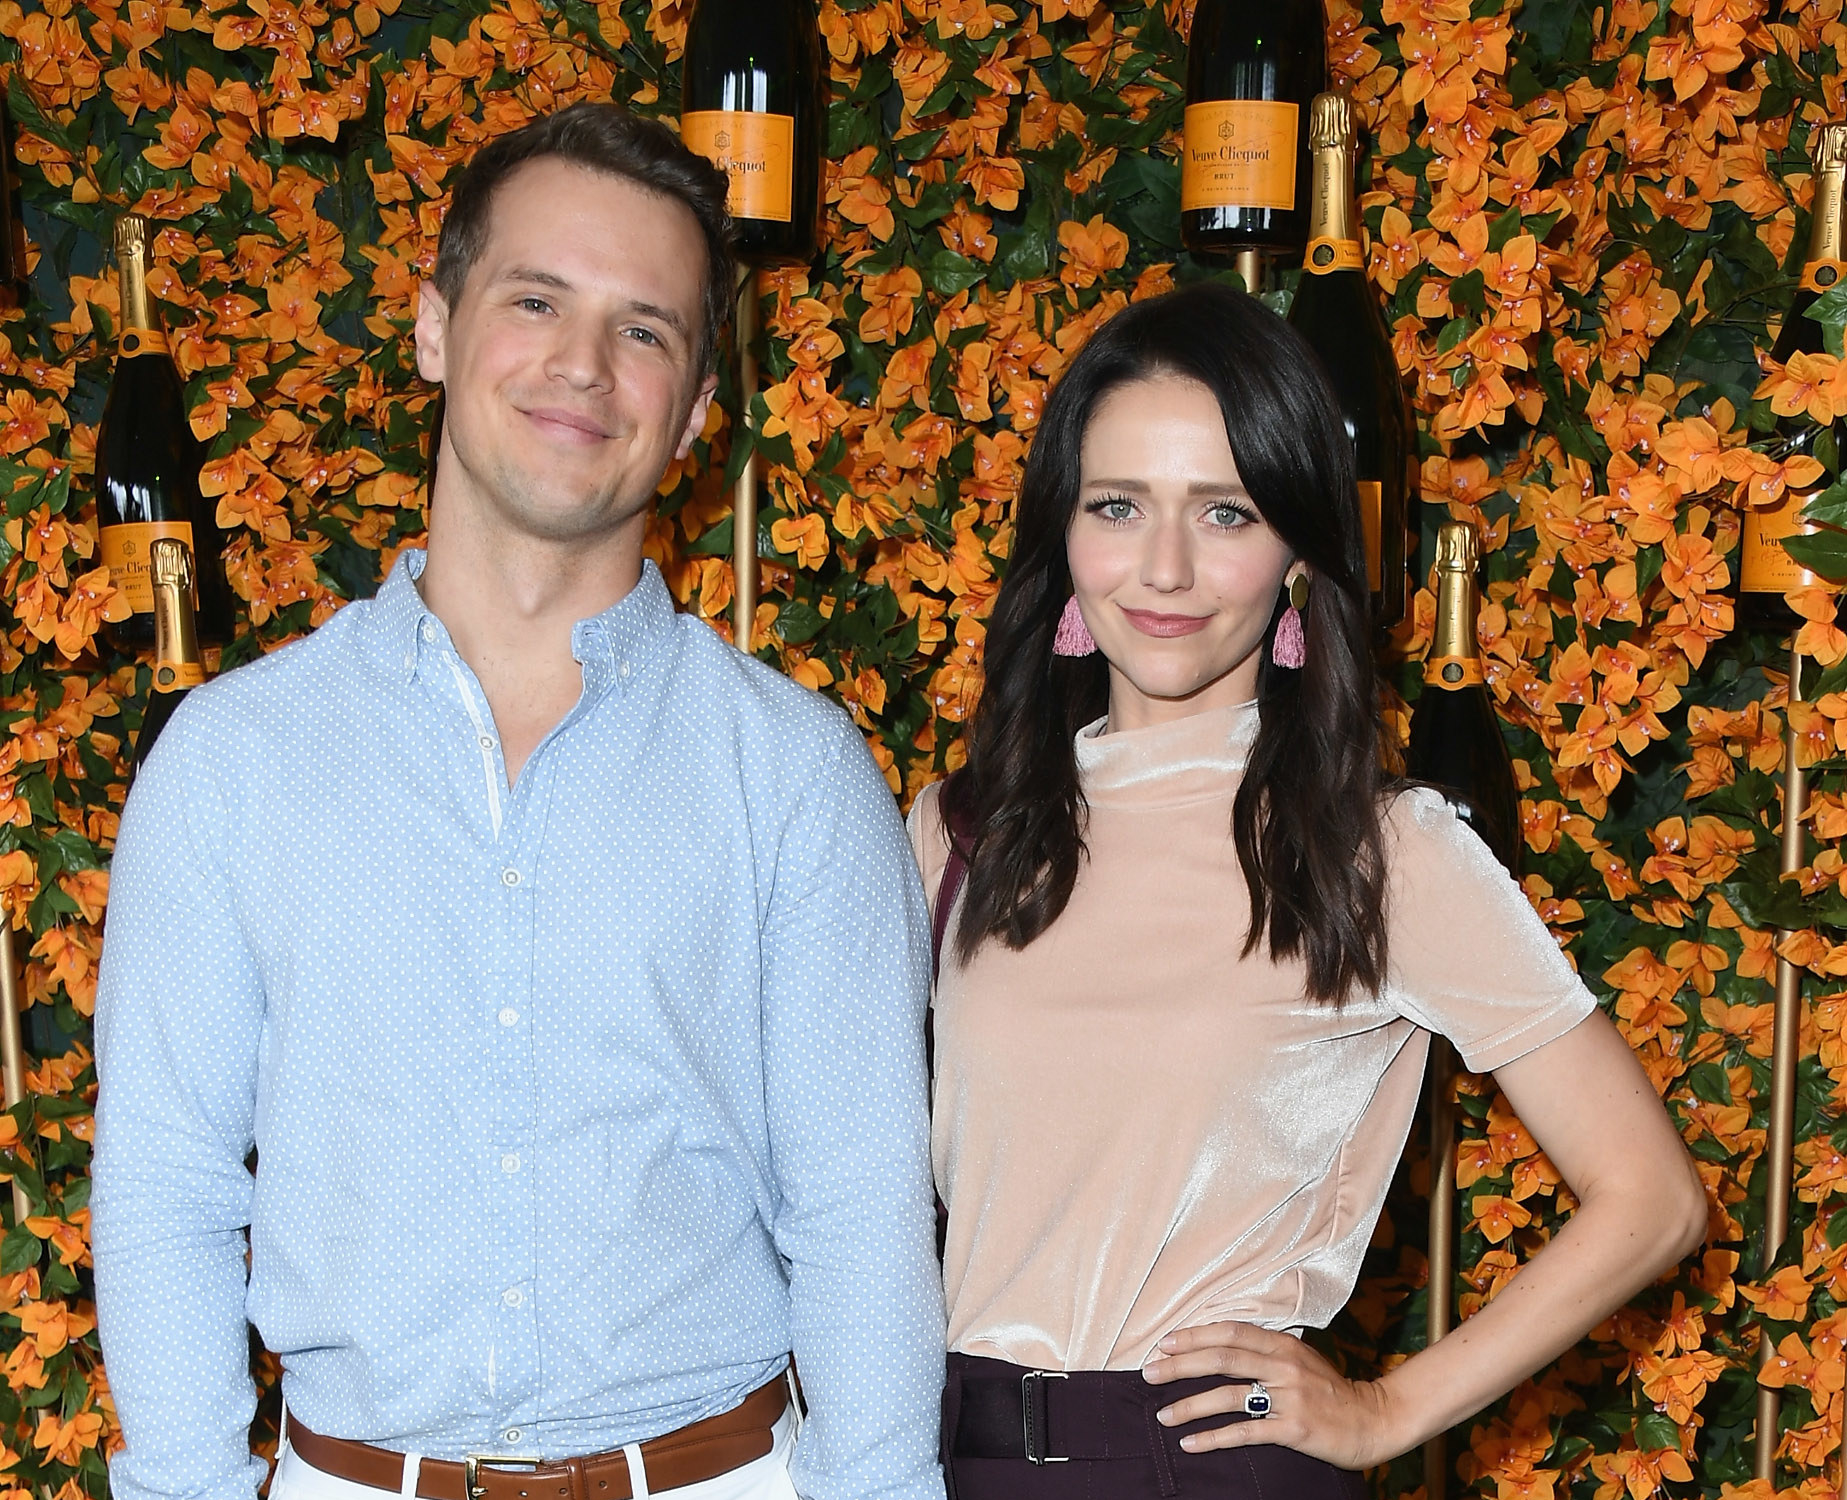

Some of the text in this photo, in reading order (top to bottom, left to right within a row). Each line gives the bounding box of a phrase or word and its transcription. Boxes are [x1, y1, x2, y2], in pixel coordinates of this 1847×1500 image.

[1192, 146, 1269, 163] Veuve Clicquot
[1823, 190, 1838, 250] Veuve Clicquot
[1759, 532, 1777, 547] Veu
